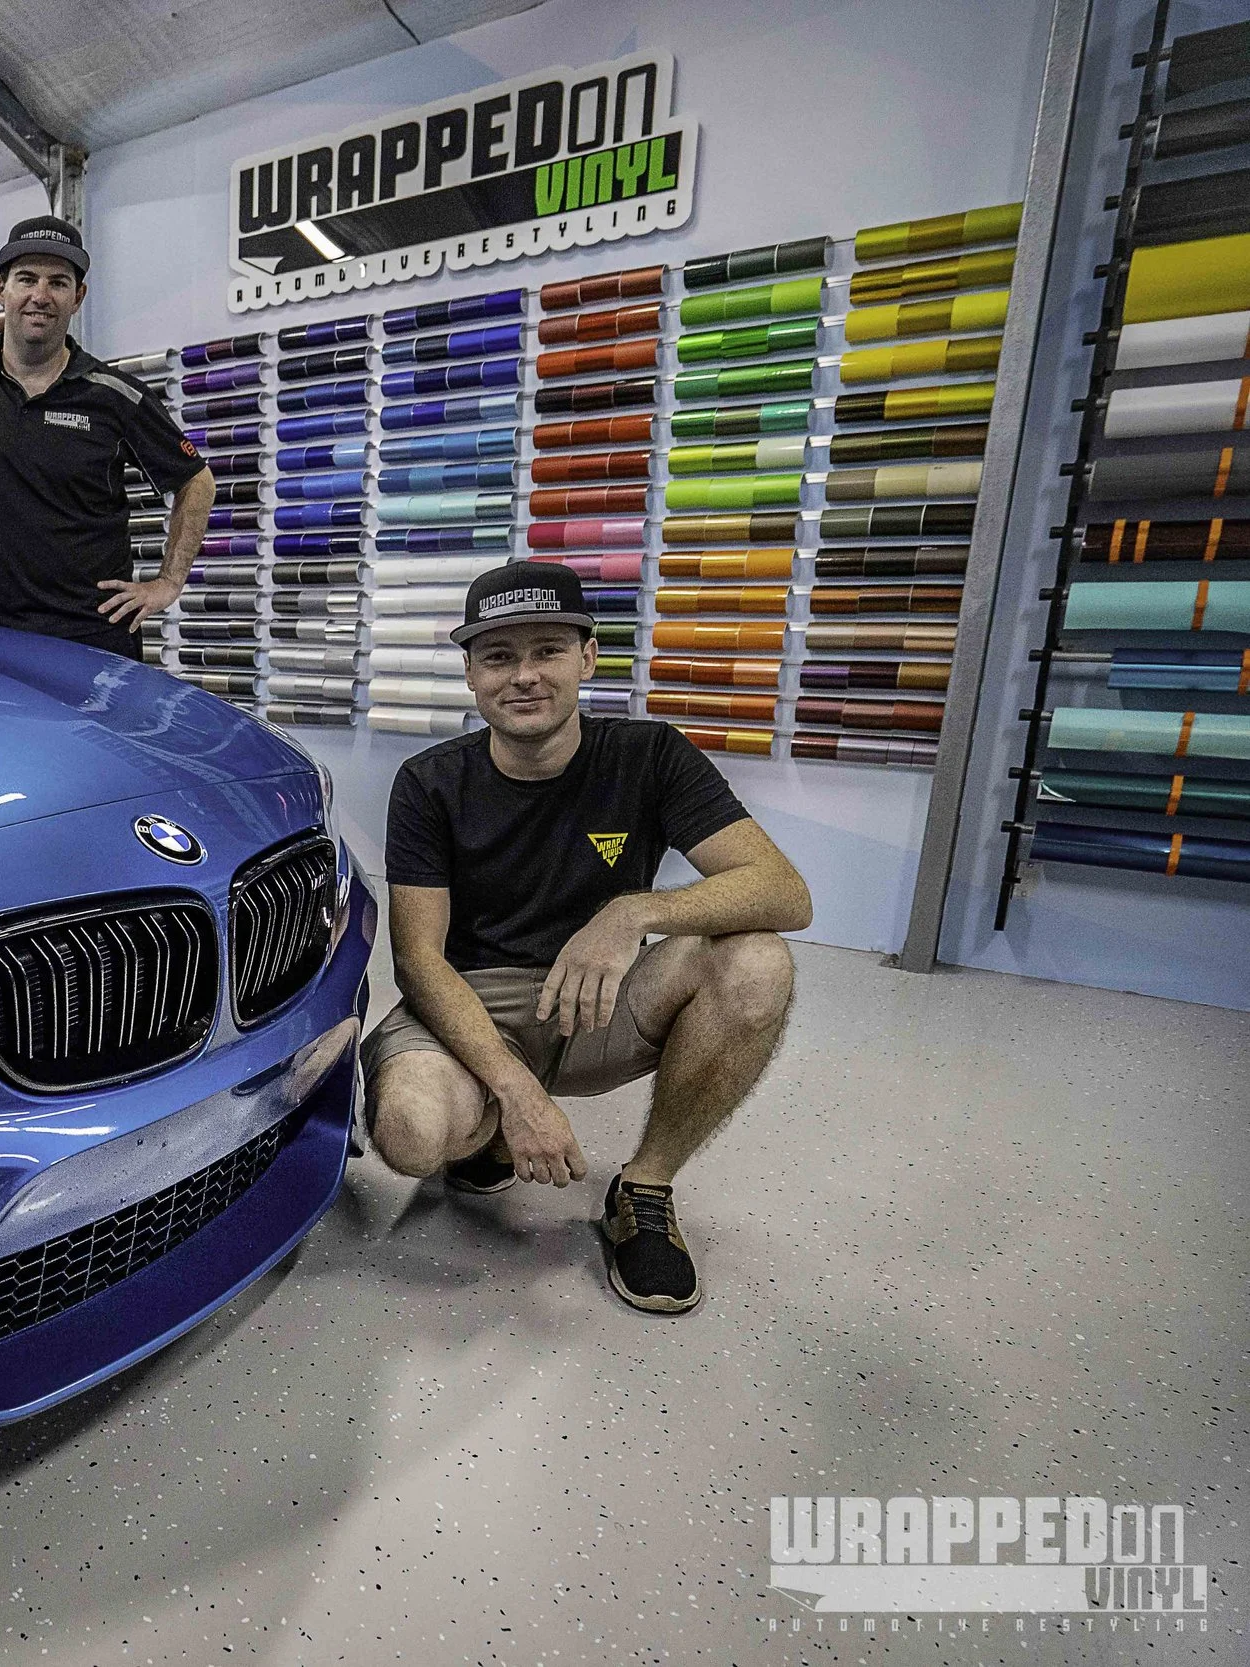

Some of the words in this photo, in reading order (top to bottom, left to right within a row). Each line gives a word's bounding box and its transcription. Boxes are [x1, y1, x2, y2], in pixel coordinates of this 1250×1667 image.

[534, 134, 677, 217] VINYL
[236, 249, 432, 304] AUTOMOIVE
[456, 199, 677, 259] RESTYLING
[535, 601, 560, 610] VINYL
[597, 837, 621, 853] WRAP
[602, 845, 623, 860] VIRUS
